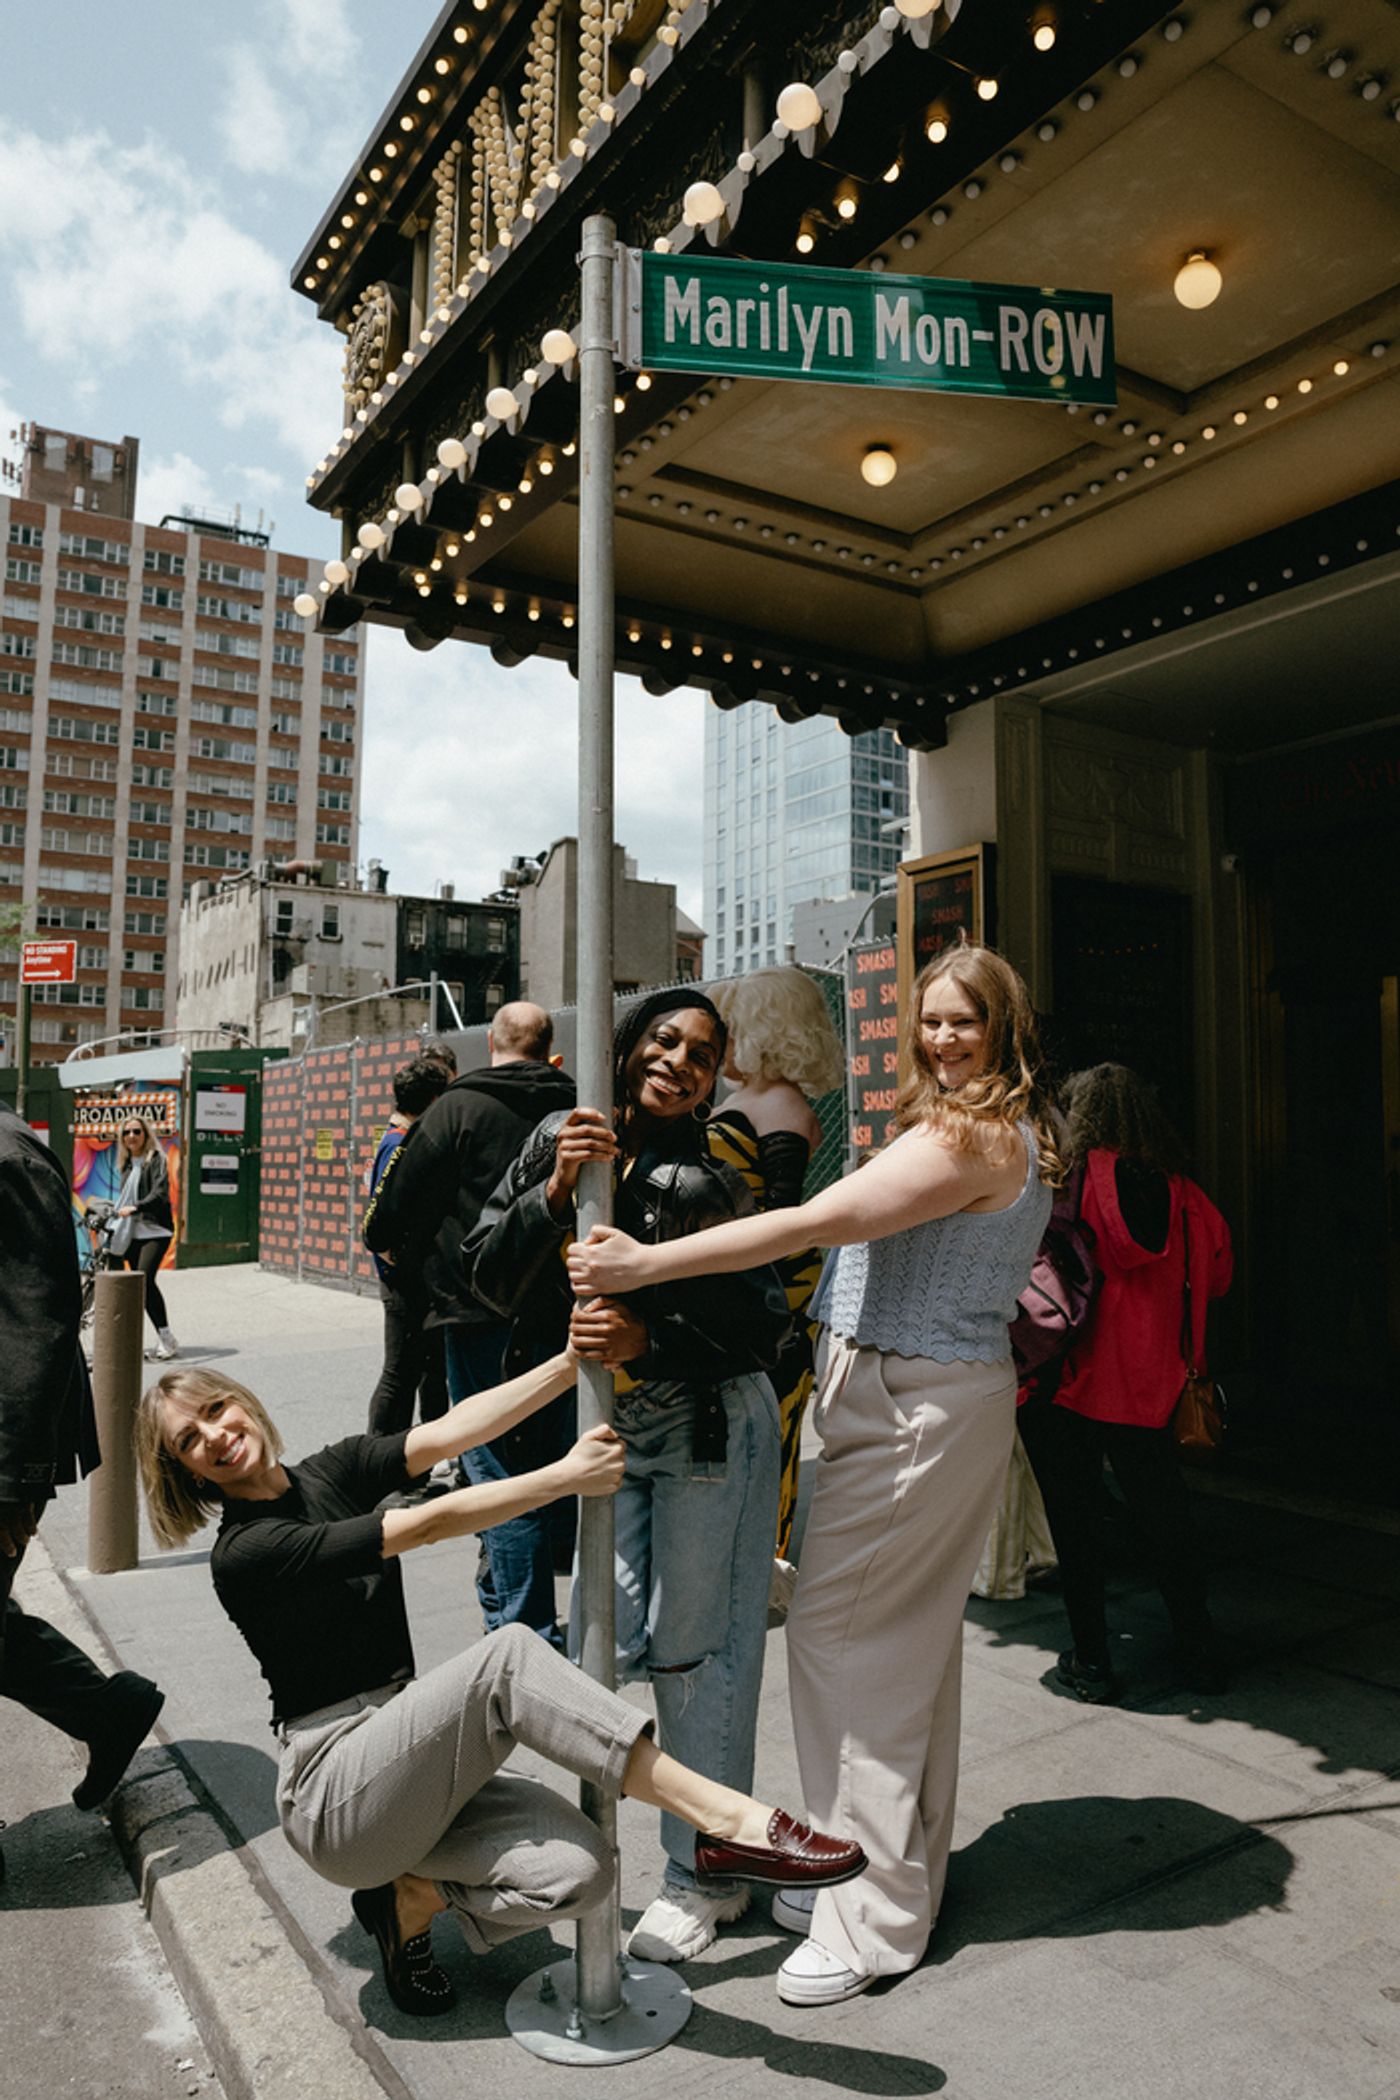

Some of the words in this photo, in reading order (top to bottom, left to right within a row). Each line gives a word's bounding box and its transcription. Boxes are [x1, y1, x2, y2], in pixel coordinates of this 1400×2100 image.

[663, 275, 854, 371] Marilyn
[874, 293, 1107, 379] Mon-ROW
[857, 948, 896, 974] SMASH
[859, 1016, 897, 1041] SMASH
